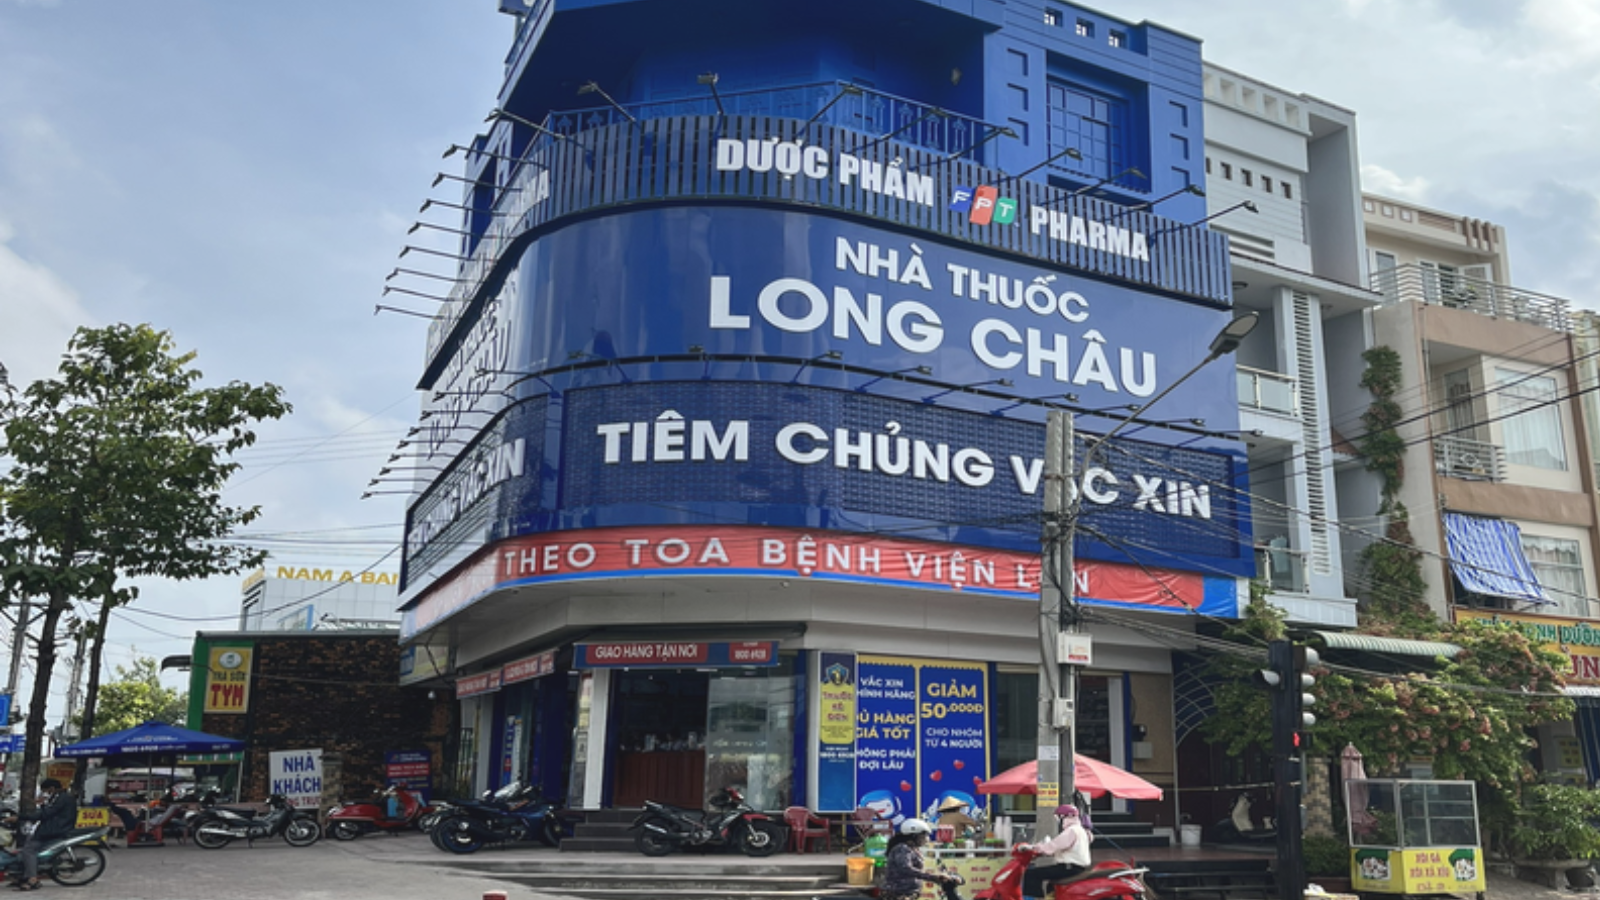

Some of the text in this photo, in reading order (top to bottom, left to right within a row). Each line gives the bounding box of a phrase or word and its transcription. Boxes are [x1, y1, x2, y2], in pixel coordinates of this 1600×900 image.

[716, 137, 934, 207] DƯỢC PHẨM
[951, 187, 1016, 221] FPT
[1031, 204, 1150, 262] PHARMA
[836, 236, 1090, 323] NHÀ THUỐC
[709, 276, 1157, 397] LONG CHÂU
[597, 410, 1212, 519] TIÊM CHỦNG VC XIN
[504, 534, 1090, 594] THEO TOA BỆNH VIỆN LN
[277, 566, 333, 582] NAM
[339, 570, 354, 583] A
[361, 572, 399, 586] BA
[595, 643, 622, 659] GIAO
[210, 683, 245, 708] TYM
[856, 686, 883, 699] HÍNH
[926, 678, 977, 699] GIẢM
[856, 708, 915, 725] Ủ HÀNG
[883, 725, 911, 740] TỐT
[926, 727, 950, 737] CHO
[283, 751, 315, 773] NHÀ
[856, 747, 887, 759] HÔNG
[273, 773, 322, 795] KHÁCH
